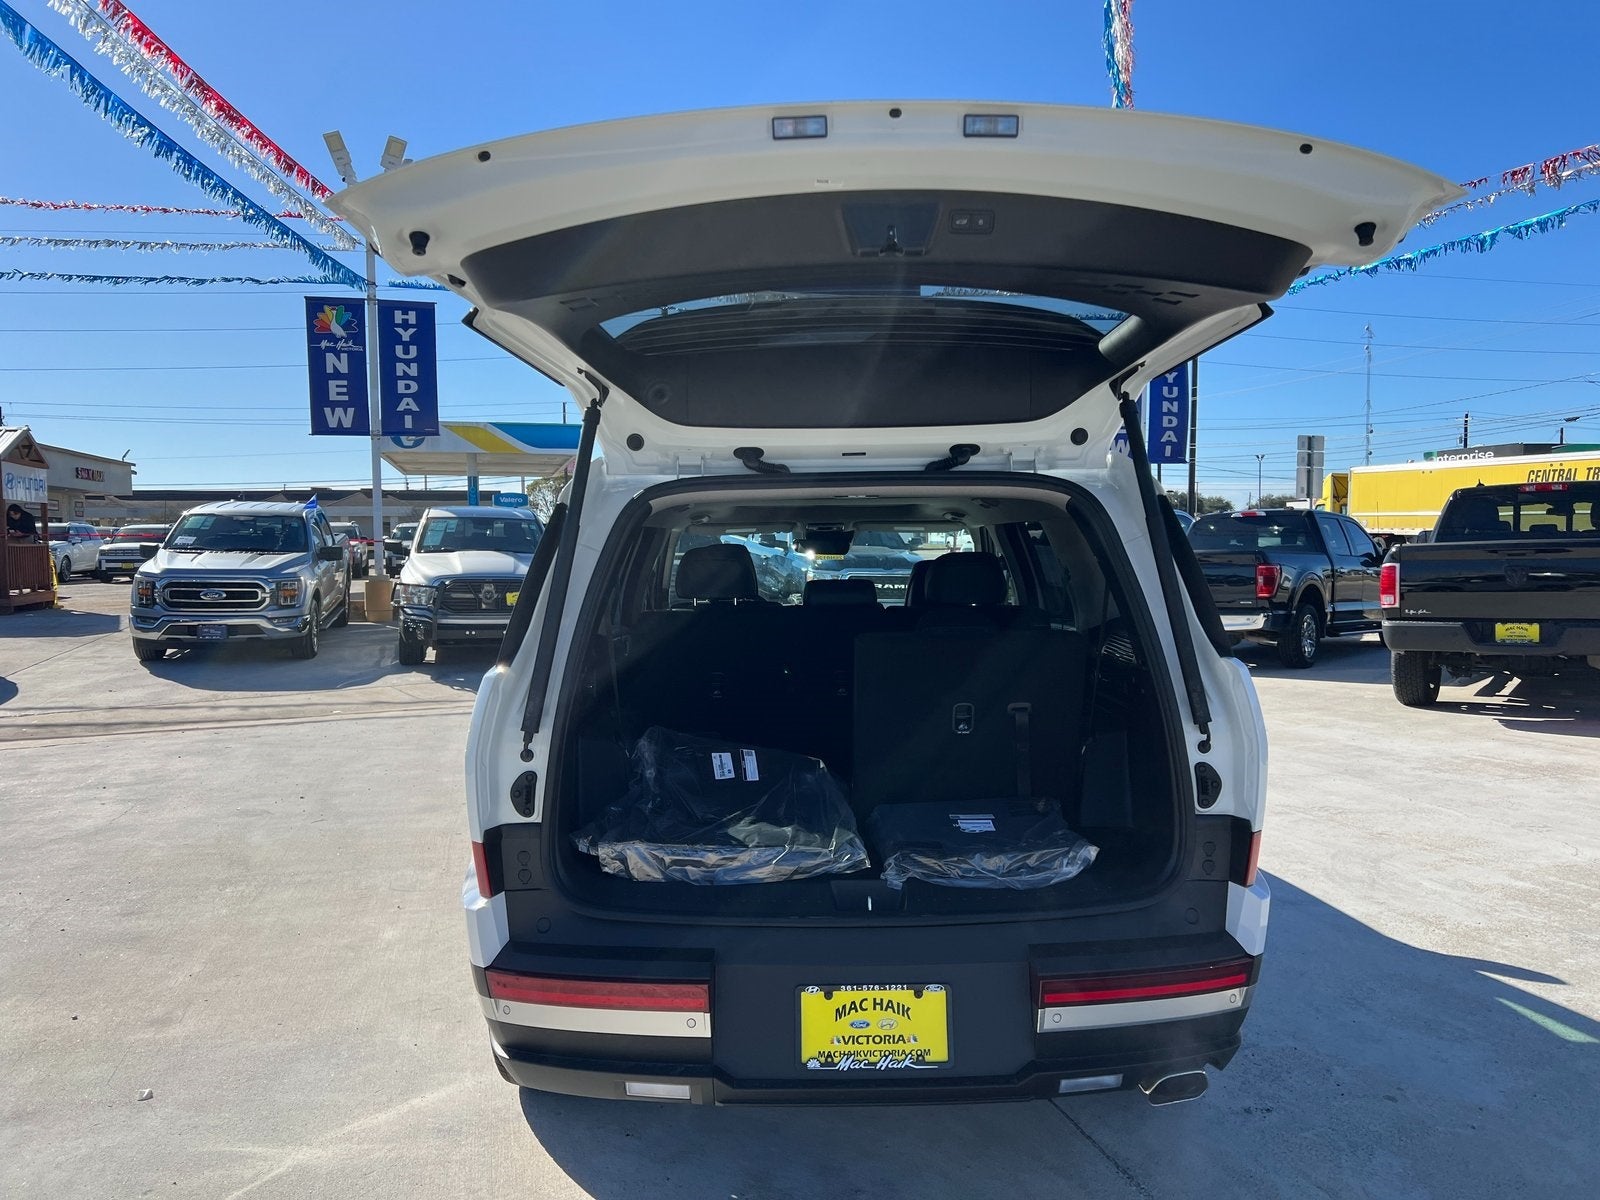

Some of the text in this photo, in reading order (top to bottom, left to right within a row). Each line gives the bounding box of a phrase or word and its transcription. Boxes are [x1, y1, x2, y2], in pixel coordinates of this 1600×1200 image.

[394, 310, 420, 429] HYUNDAI
[324, 353, 354, 428] NEW
[1161, 372, 1179, 457] YUNDAI
[1527, 468, 1578, 482] CENTRAL
[835, 997, 912, 1022] MAC HAIK
[851, 1020, 870, 1029] Ford
[841, 1034, 907, 1046] VICTORIA
[837, 1053, 922, 1071] Mac Haik
